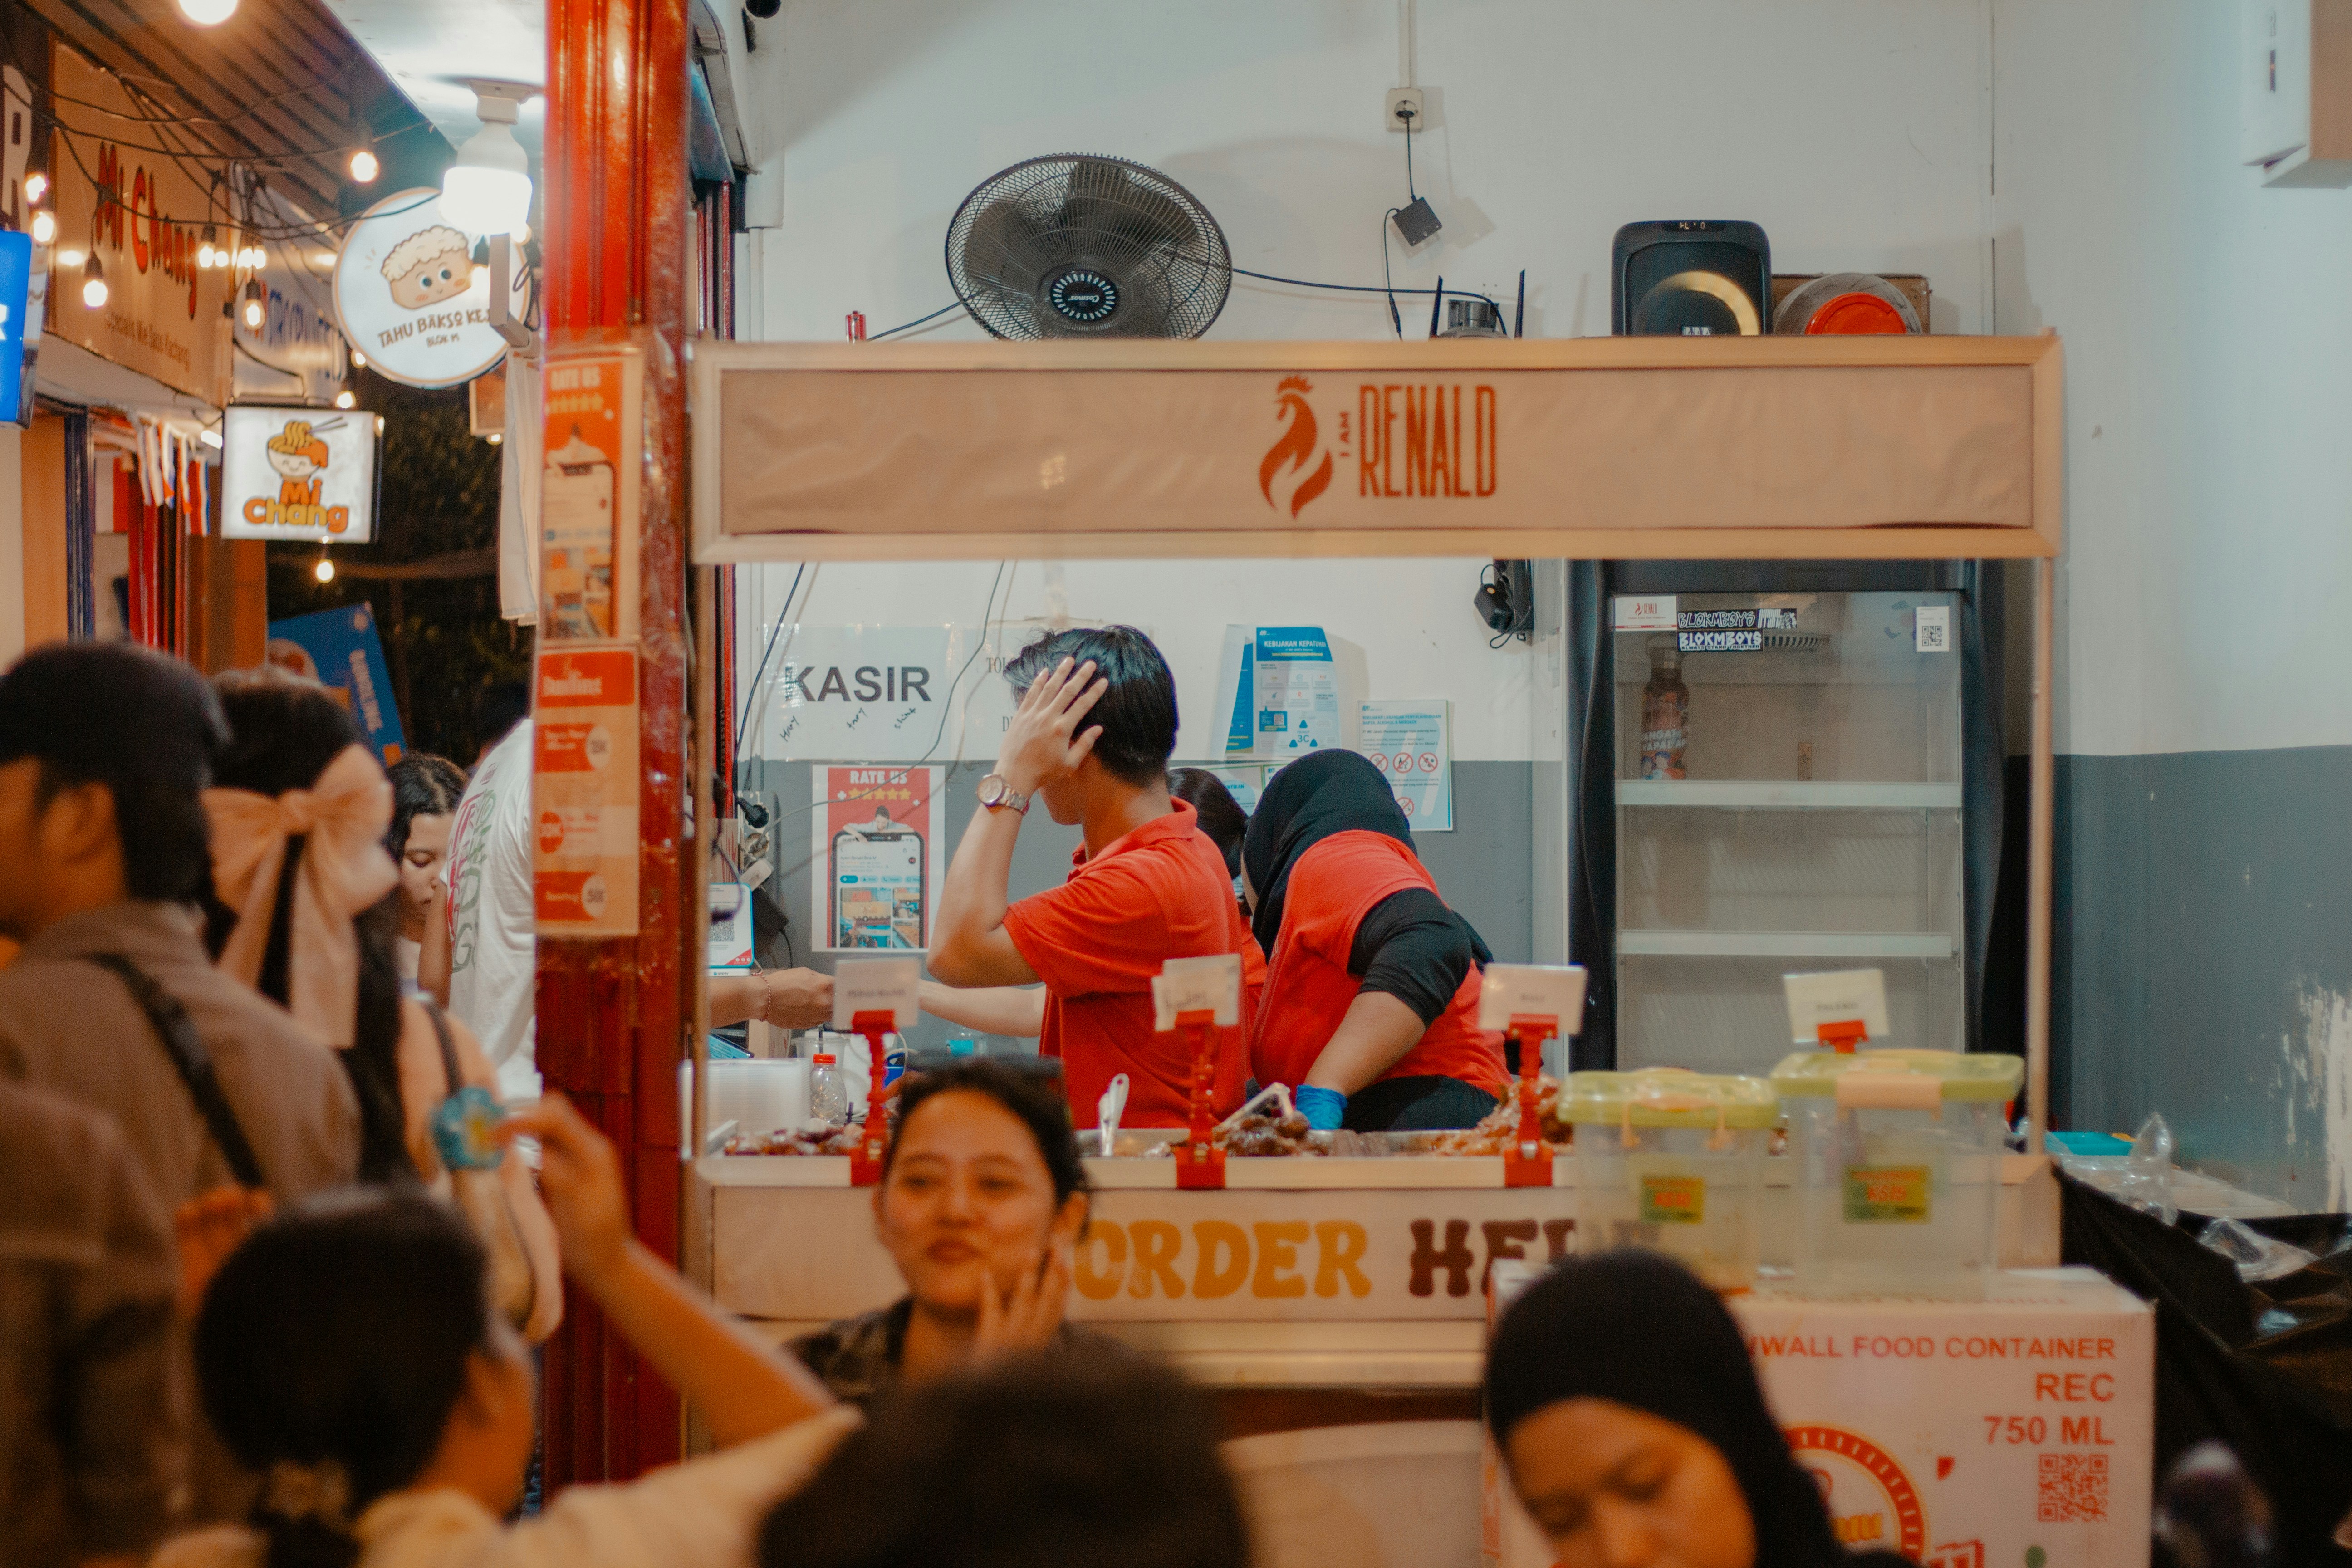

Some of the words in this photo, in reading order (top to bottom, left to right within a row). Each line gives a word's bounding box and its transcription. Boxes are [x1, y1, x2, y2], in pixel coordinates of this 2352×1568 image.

[377, 320, 413, 349] TAHU
[426, 334, 448, 348] BLOK
[450, 333, 460, 343] M
[1360, 385, 1496, 497] RENALD
[279, 478, 323, 505] Mi
[243, 497, 349, 534] Chang
[1644, 603, 1658, 614] RENALD
[785, 666, 932, 702] KASIR
[1298, 735, 1309, 743] 3C
[850, 770, 885, 784] RATE
[890, 770, 908, 784] US
[1073, 1219, 1372, 1300] ORDER
[1750, 1336, 1843, 1358] WALL
[1852, 1336, 1936, 1358] FOOD
[1945, 1337, 2116, 1361] CONTAINER
[2035, 1372, 2116, 1403] REC
[1984, 1416, 2047, 1446] 750
[2060, 1416, 2116, 1445] ML
